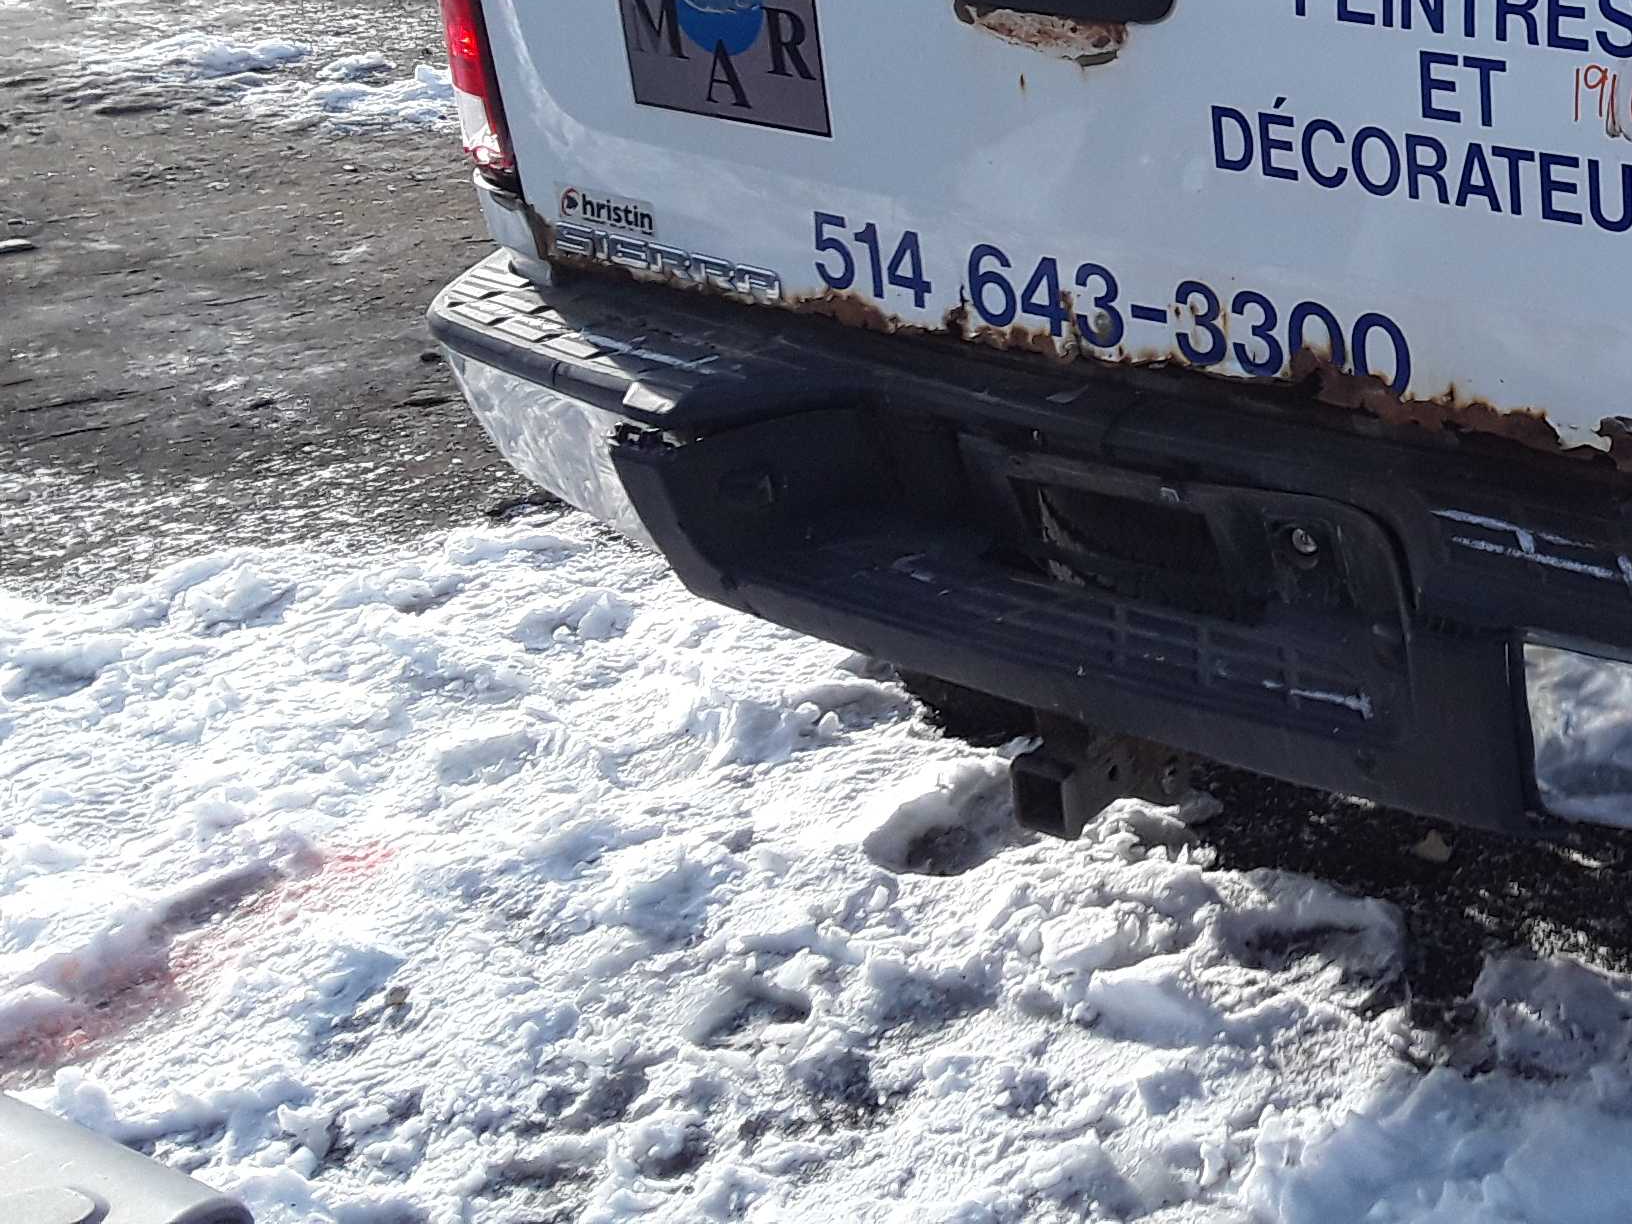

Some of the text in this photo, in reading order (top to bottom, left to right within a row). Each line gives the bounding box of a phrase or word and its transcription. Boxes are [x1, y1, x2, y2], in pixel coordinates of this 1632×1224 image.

[1419, 51, 1505, 127] ET
[555, 221, 783, 301] SIERRA
[814, 211, 1410, 398] 514 643-3300
